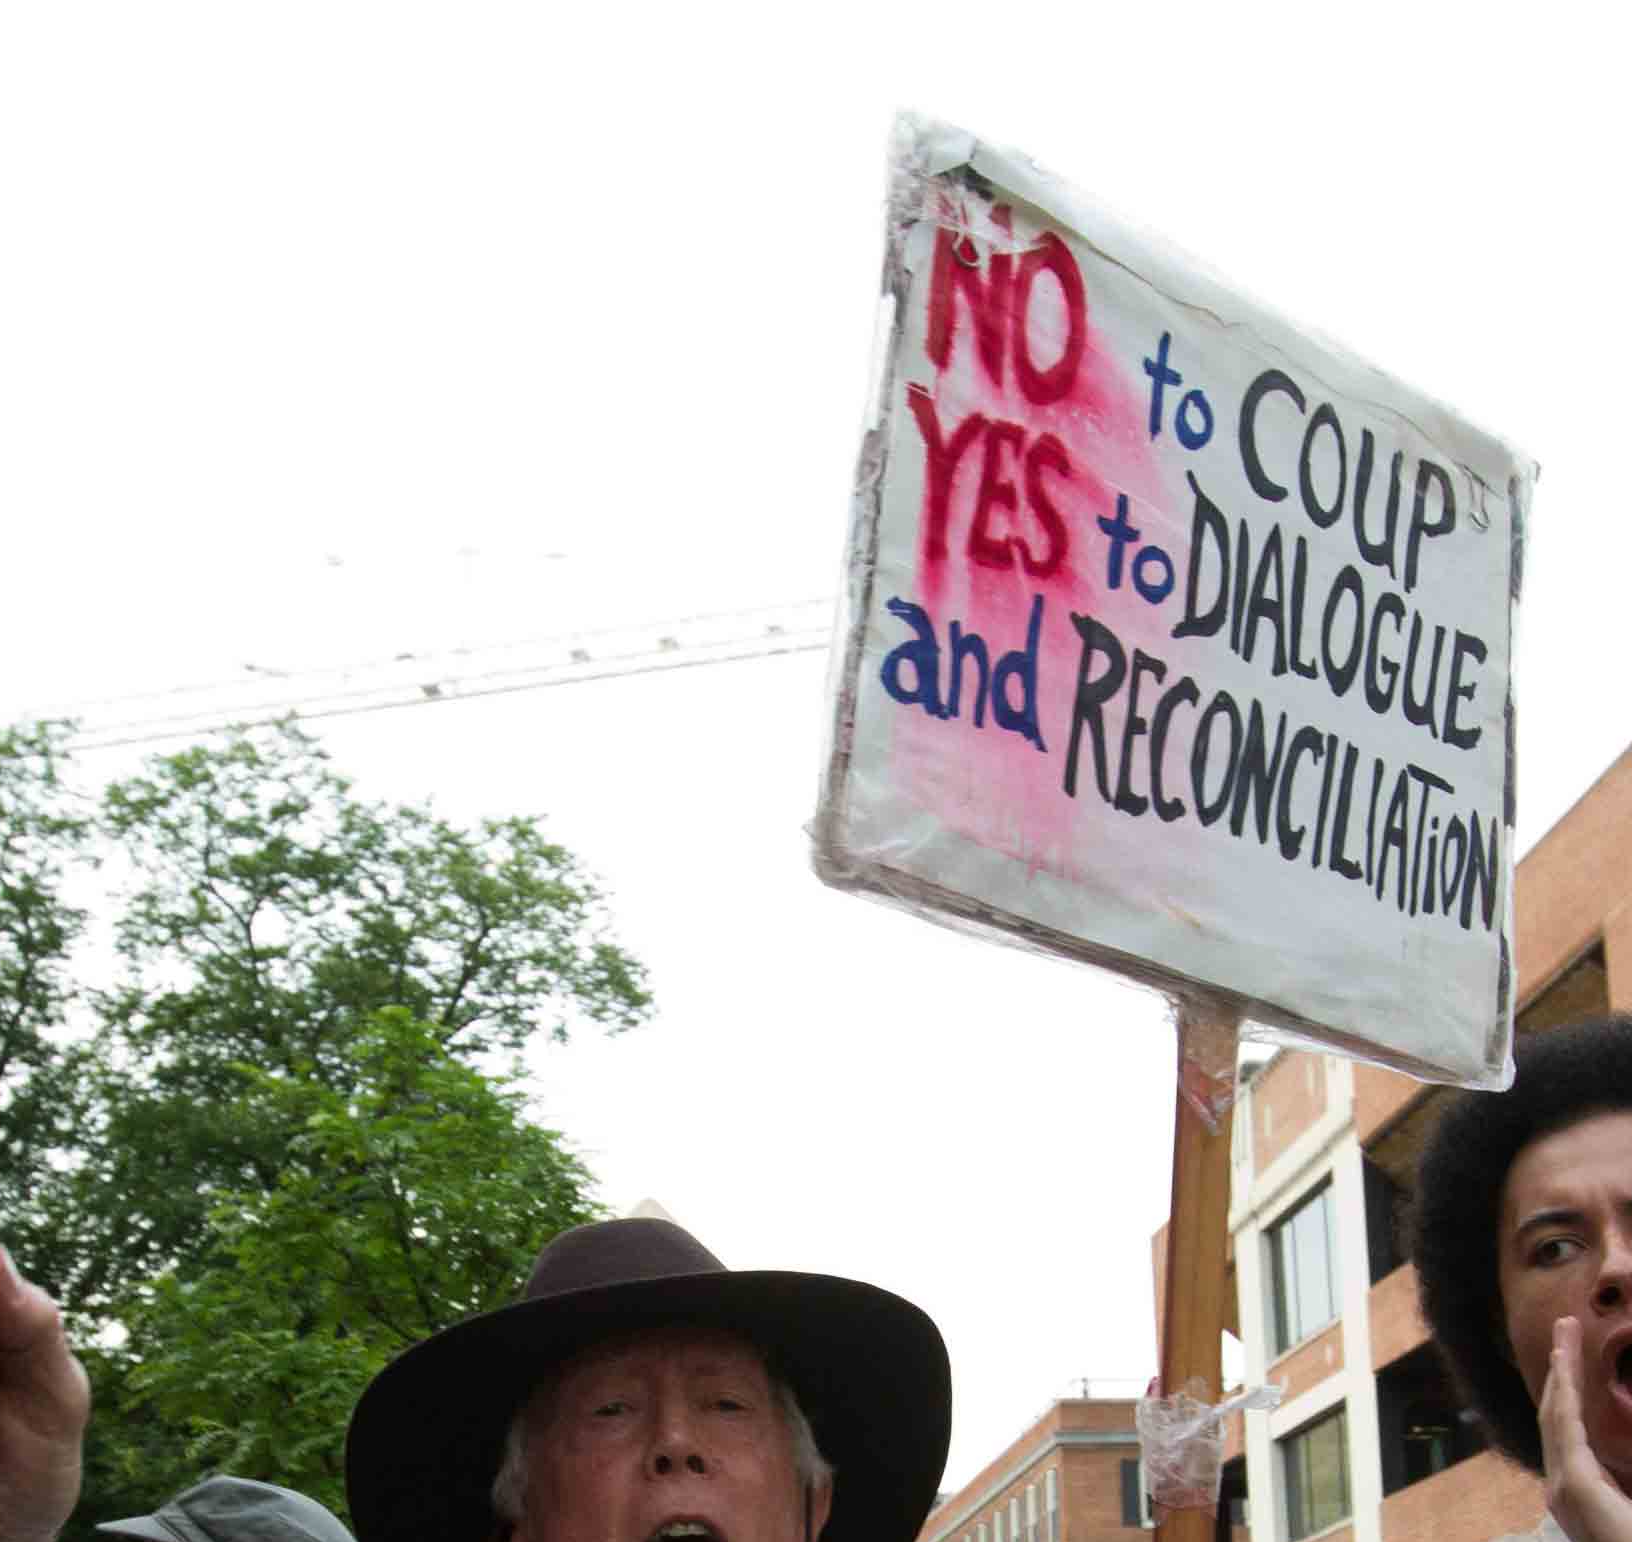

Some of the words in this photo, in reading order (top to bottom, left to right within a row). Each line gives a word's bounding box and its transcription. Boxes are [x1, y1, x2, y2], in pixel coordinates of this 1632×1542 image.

[906, 383, 1070, 581] YES
[1097, 493, 1175, 605] to
[1171, 469, 1487, 750] DIALOGUE
[925, 196, 1087, 407] NO
[1142, 331, 1215, 450] to
[1239, 369, 1456, 594] COUP
[880, 594, 1047, 753] and
[1063, 610, 1500, 931] RECONCILIATION
